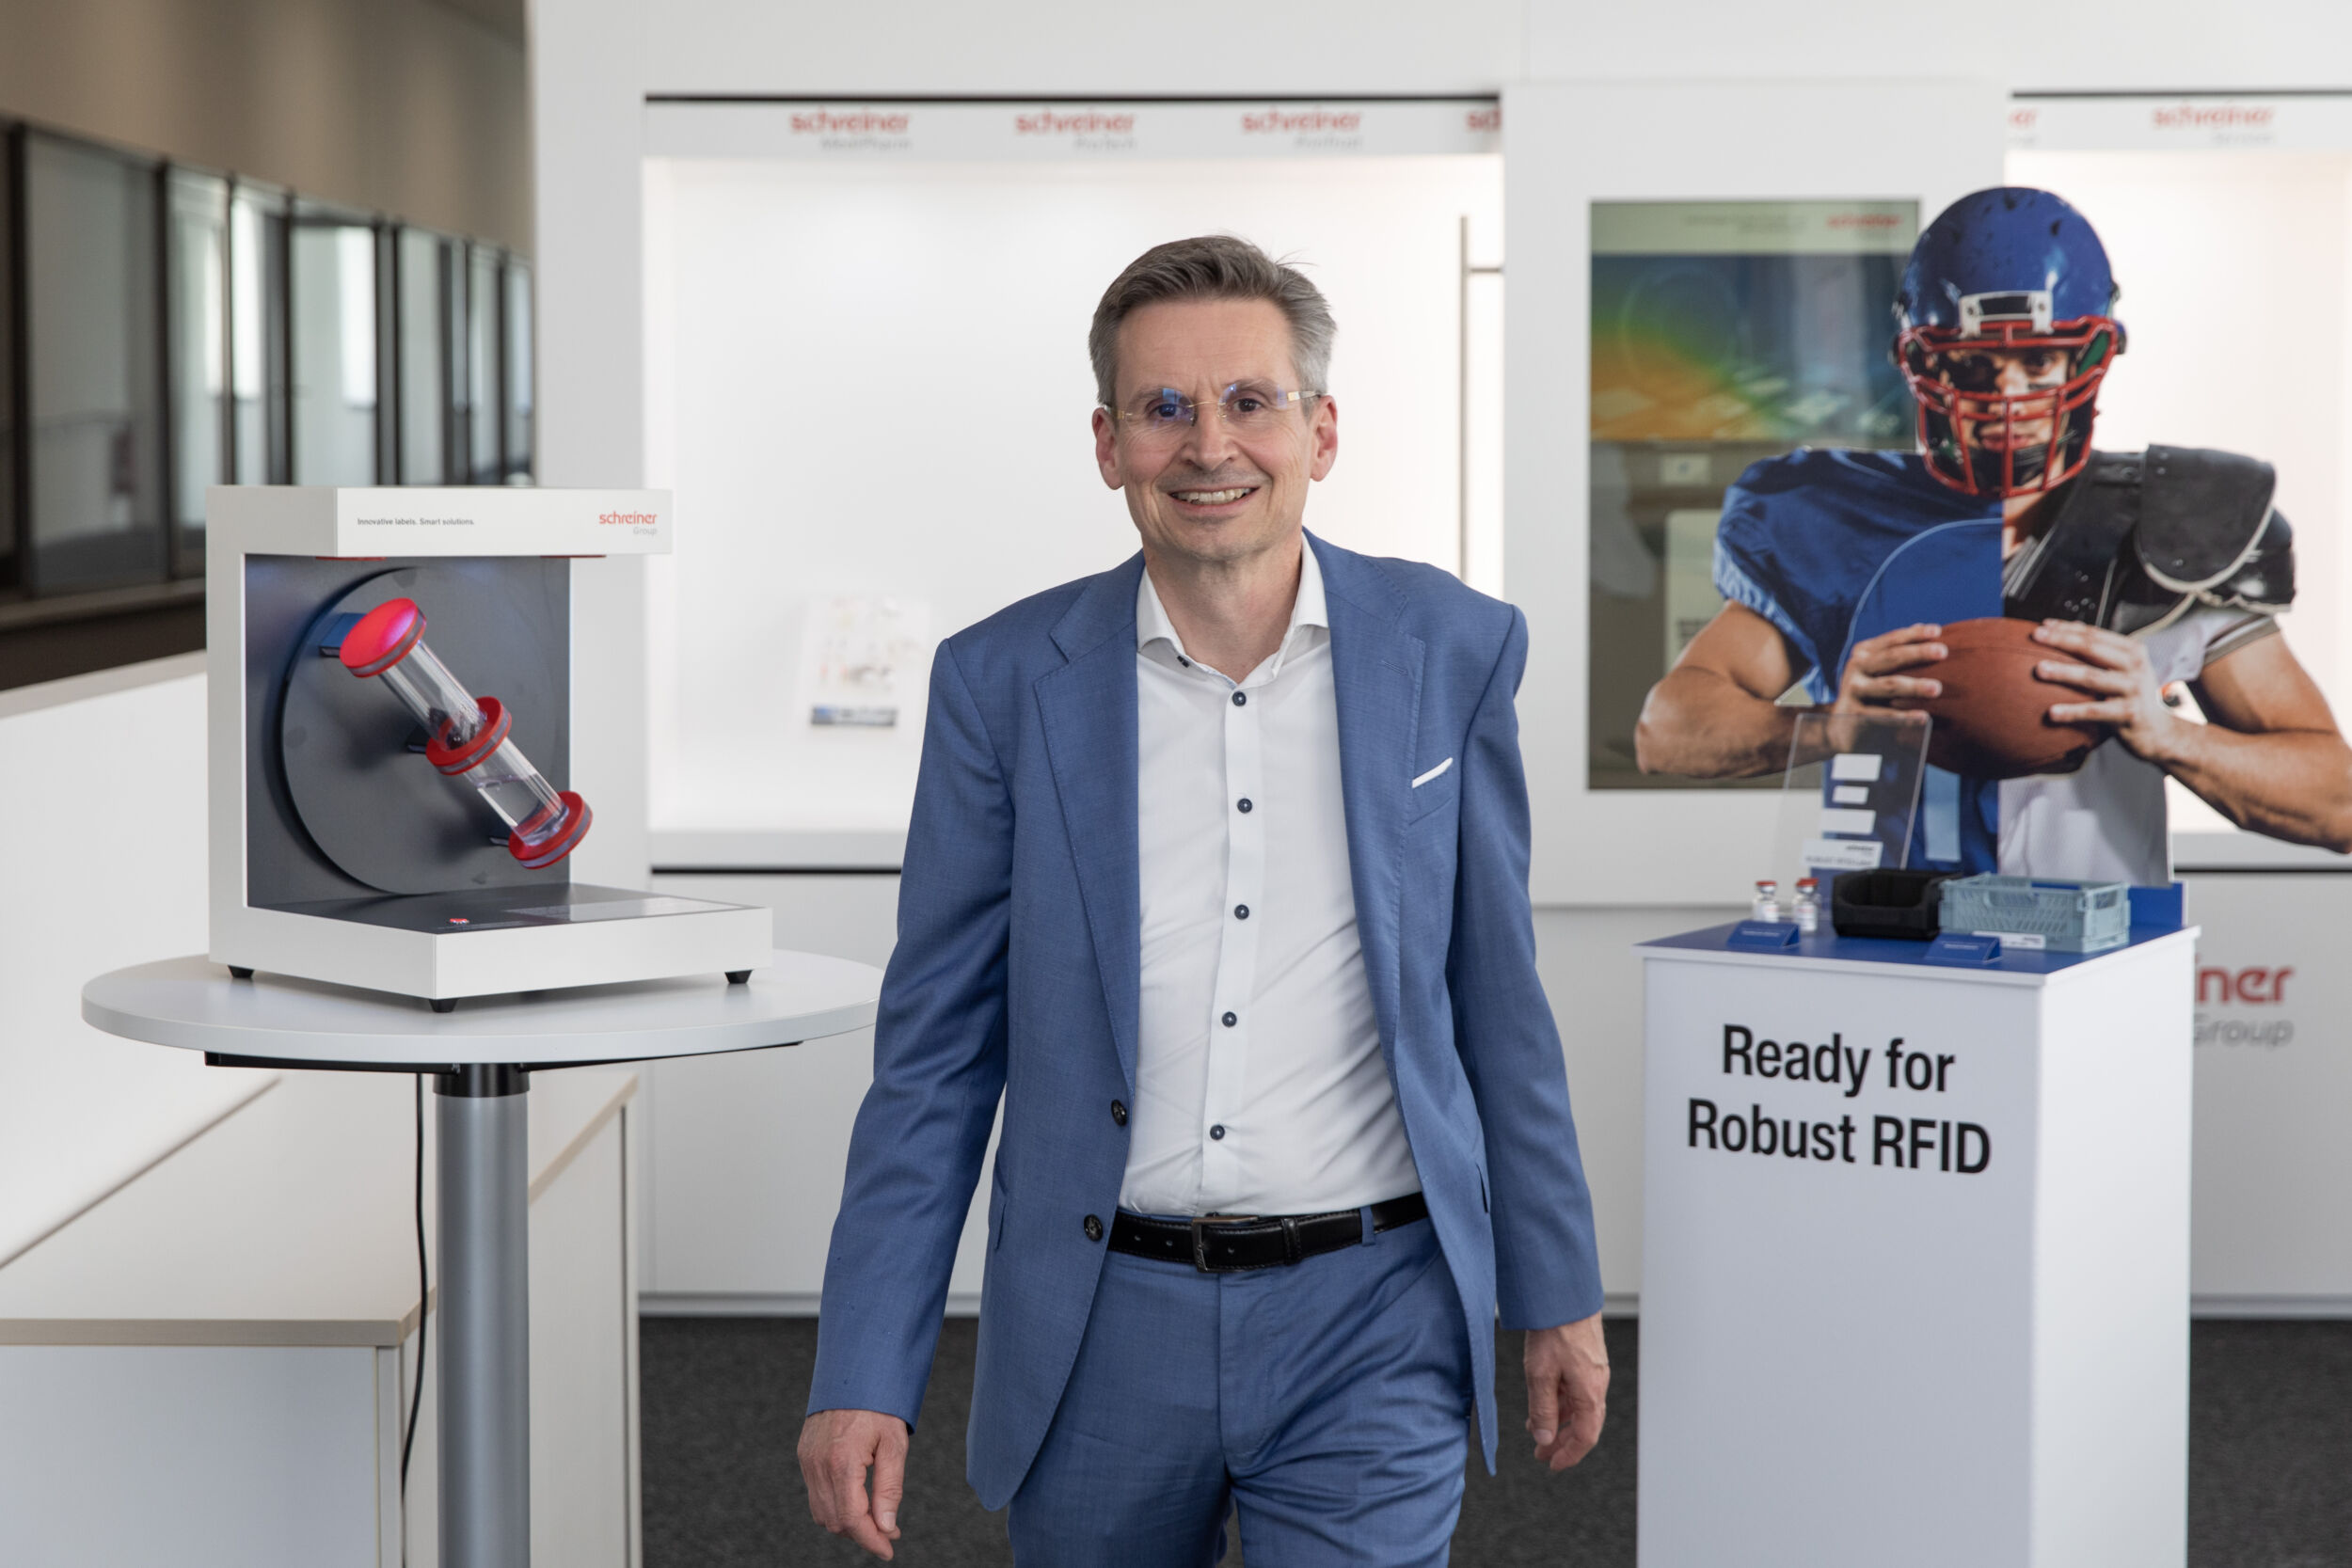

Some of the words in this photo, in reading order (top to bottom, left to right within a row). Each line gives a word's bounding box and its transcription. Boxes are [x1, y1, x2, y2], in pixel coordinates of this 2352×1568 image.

[789, 107, 910, 133] schreiner
[1015, 107, 1136, 133] schreiner
[1241, 106, 1361, 132] schreiner
[2153, 102, 2275, 128] schreiner
[357, 517, 393, 526] Innovative
[394, 517, 416, 526] labels.
[420, 517, 440, 526] Smart
[442, 517, 474, 526] solutions.
[599, 510, 657, 525] schreiner
[633, 528, 657, 536] Group
[1723, 1023, 1870, 1098] Ready
[1884, 1037, 1955, 1092] for
[1688, 1098, 1856, 1164] Robust
[1872, 1115, 1991, 1174] RFID
